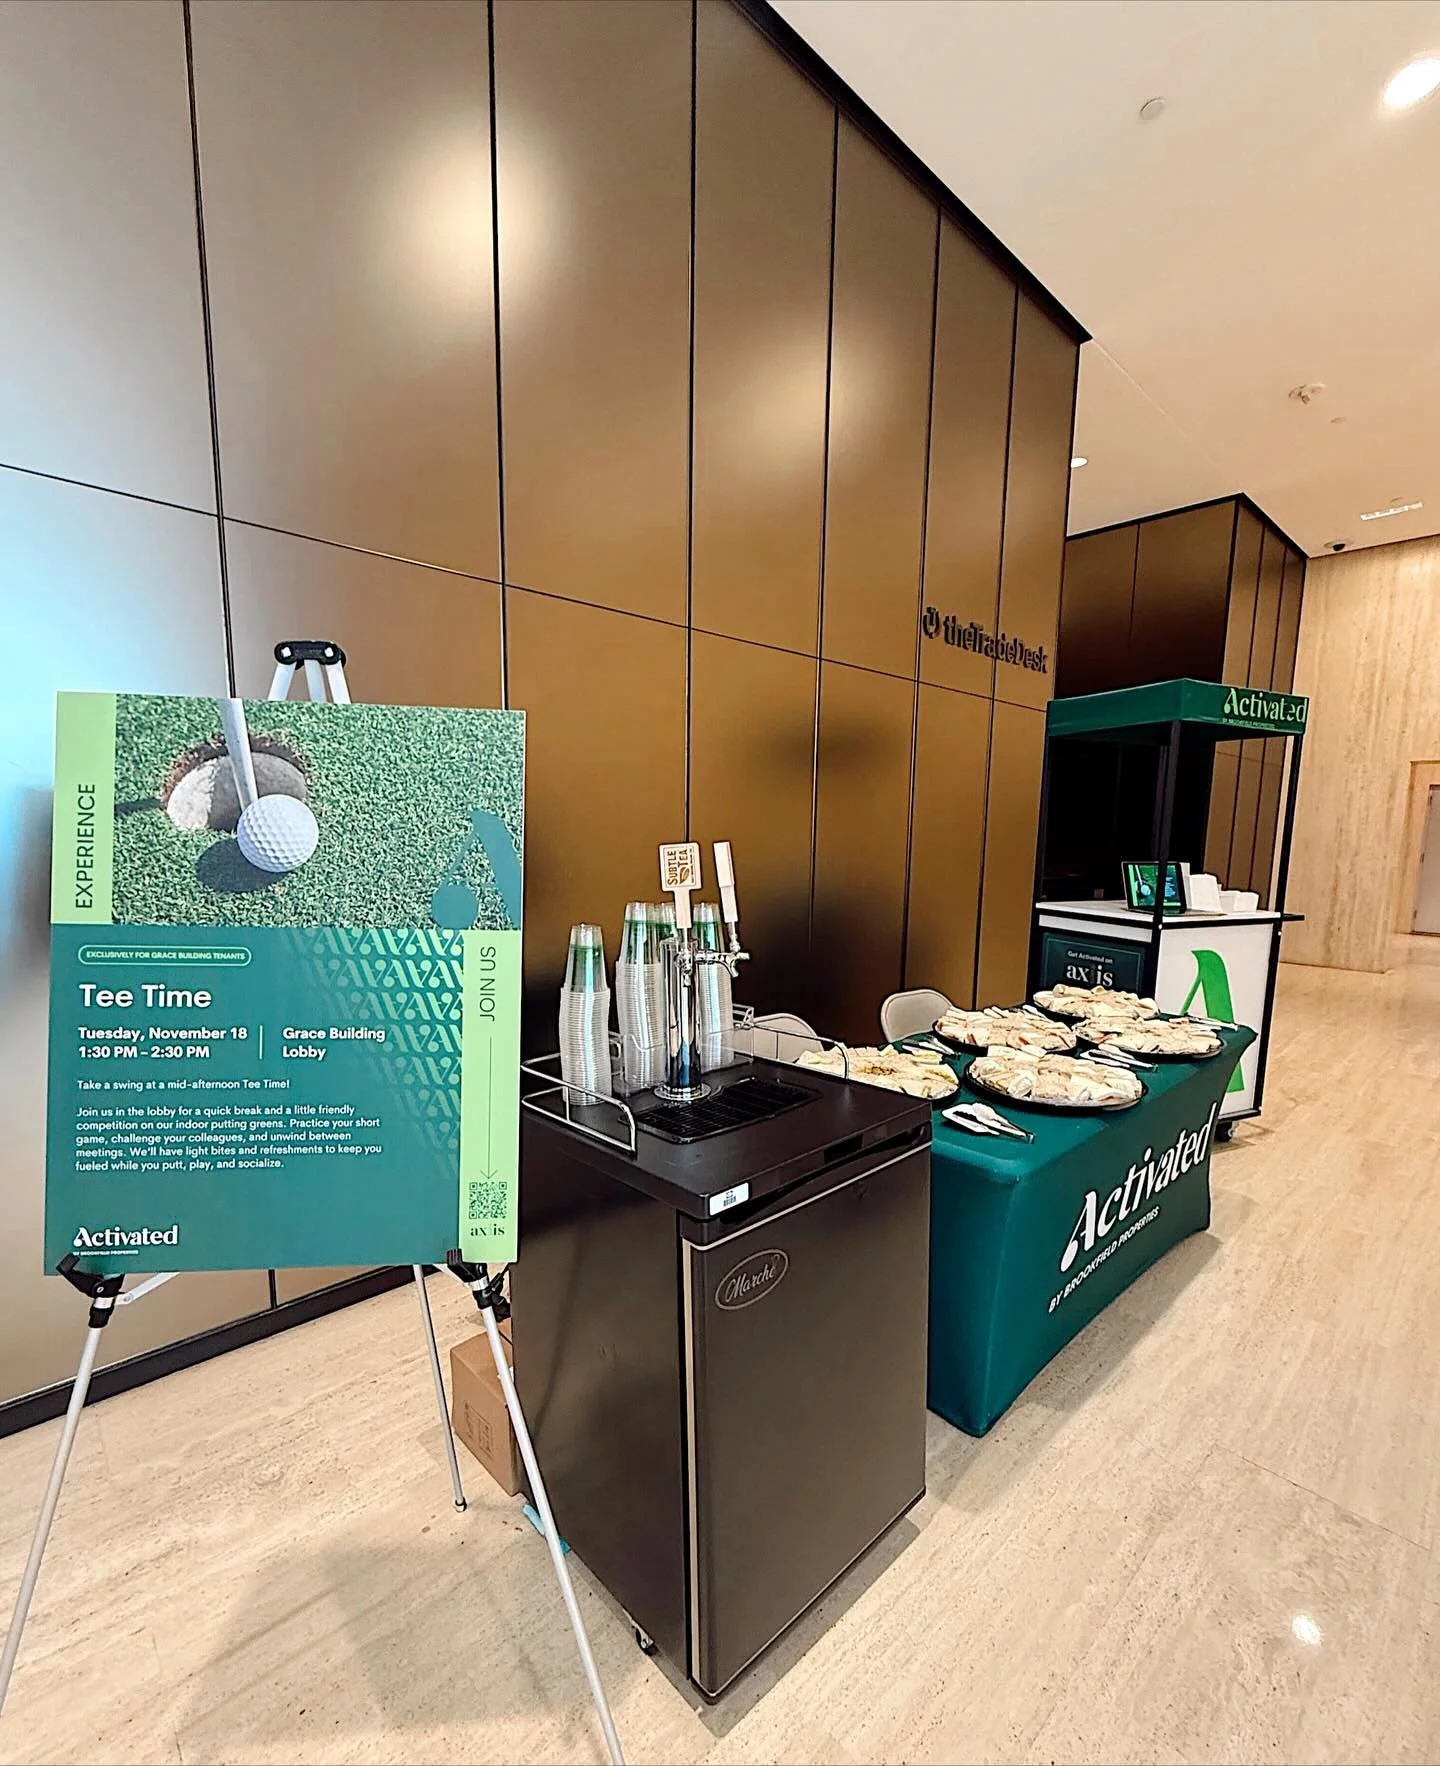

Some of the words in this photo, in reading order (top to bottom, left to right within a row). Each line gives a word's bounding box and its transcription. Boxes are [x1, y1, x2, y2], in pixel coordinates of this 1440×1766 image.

[1224, 688, 1308, 723] Activated
[75, 784, 95, 908] EXPERIENCE
[678, 849, 689, 868] TEA
[667, 850, 678, 885] SUBTLE
[86, 951, 134, 959] EXCLUSIVELY
[151, 952, 177, 960] GRACE
[178, 952, 212, 960] BUILDING
[213, 952, 245, 960] TENANTS
[480, 946, 496, 971] US
[1067, 950, 1078, 958] Get
[79, 984, 134, 1008] Tee
[141, 984, 212, 1008] Time
[480, 978, 495, 1022] JOIN
[78, 1027, 145, 1042] Tuesday,
[149, 1027, 227, 1039] November
[231, 1027, 248, 1039] 18
[283, 1027, 326, 1039] Grace
[329, 1027, 386, 1042] Building
[79, 1046, 111, 1058] 1:30
[114, 1046, 138, 1058] PM
[150, 1046, 183, 1058] 2:30
[186, 1046, 210, 1058] PM
[283, 1045, 326, 1061] Lobby
[78, 1080, 102, 1090] Take
[103, 1082, 111, 1090] a
[113, 1080, 143, 1092] swing
[146, 1080, 156, 1089] at
[158, 1081, 165, 1089] a
[168, 1079, 240, 1090] mid-afternoon
[243, 1079, 260, 1089] Tee
[263, 1079, 290, 1089] Time!
[77, 1107, 98, 1117] Join
[101, 1109, 113, 1117] us
[116, 1107, 125, 1116] in
[128, 1107, 144, 1116] the
[147, 1106, 176, 1118] lobby
[178, 1106, 192, 1116] for
[203, 1106, 231, 1118] quick
[234, 1105, 262, 1115] break
[264, 1105, 283, 1115] and
[286, 1107, 292, 1115] a
[294, 1105, 316, 1114] little
[318, 1104, 355, 1116] friendly
[76, 1120, 138, 1132] competition
[156, 1121, 173, 1129] our
[175, 1119, 208, 1129] indoor
[211, 1119, 247, 1131] putting
[250, 1121, 287, 1131] greens.
[289, 1118, 329, 1128] Practice
[332, 1119, 353, 1129] your
[355, 1118, 380, 1127] short
[76, 1136, 108, 1146] game,
[111, 1133, 161, 1145] challenge
[164, 1135, 186, 1145] your
[188, 1132, 247, 1144] colleagues,
[249, 1132, 268, 1141] and
[270, 1131, 307, 1141] unwind
[309, 1131, 351, 1141] between
[76, 1147, 127, 1159] meetings.
[129, 1146, 157, 1156] We'll
[159, 1147, 183, 1156] have
[186, 1146, 208, 1158] light
[211, 1145, 236, 1155] bites
[238, 1145, 257, 1155] and
[260, 1144, 323, 1155] refreshments
[325, 1145, 335, 1153] to
[338, 1144, 362, 1155] keep
[364, 1145, 382, 1155] you
[75, 1161, 109, 1171] fueled
[111, 1160, 139, 1170] while
[141, 1162, 159, 1172] you
[162, 1160, 186, 1172] putt,
[189, 1159, 214, 1172] play,
[216, 1159, 235, 1169] and
[238, 1158, 284, 1168] socialize.
[1060, 1102, 1217, 1272] Activated
[73, 1224, 178, 1247] Activated
[1049, 1290, 1064, 1313] BY
[1063, 1241, 1118, 1299] BROOKFIELD
[1117, 1206, 1160, 1248] PROPERTIES
